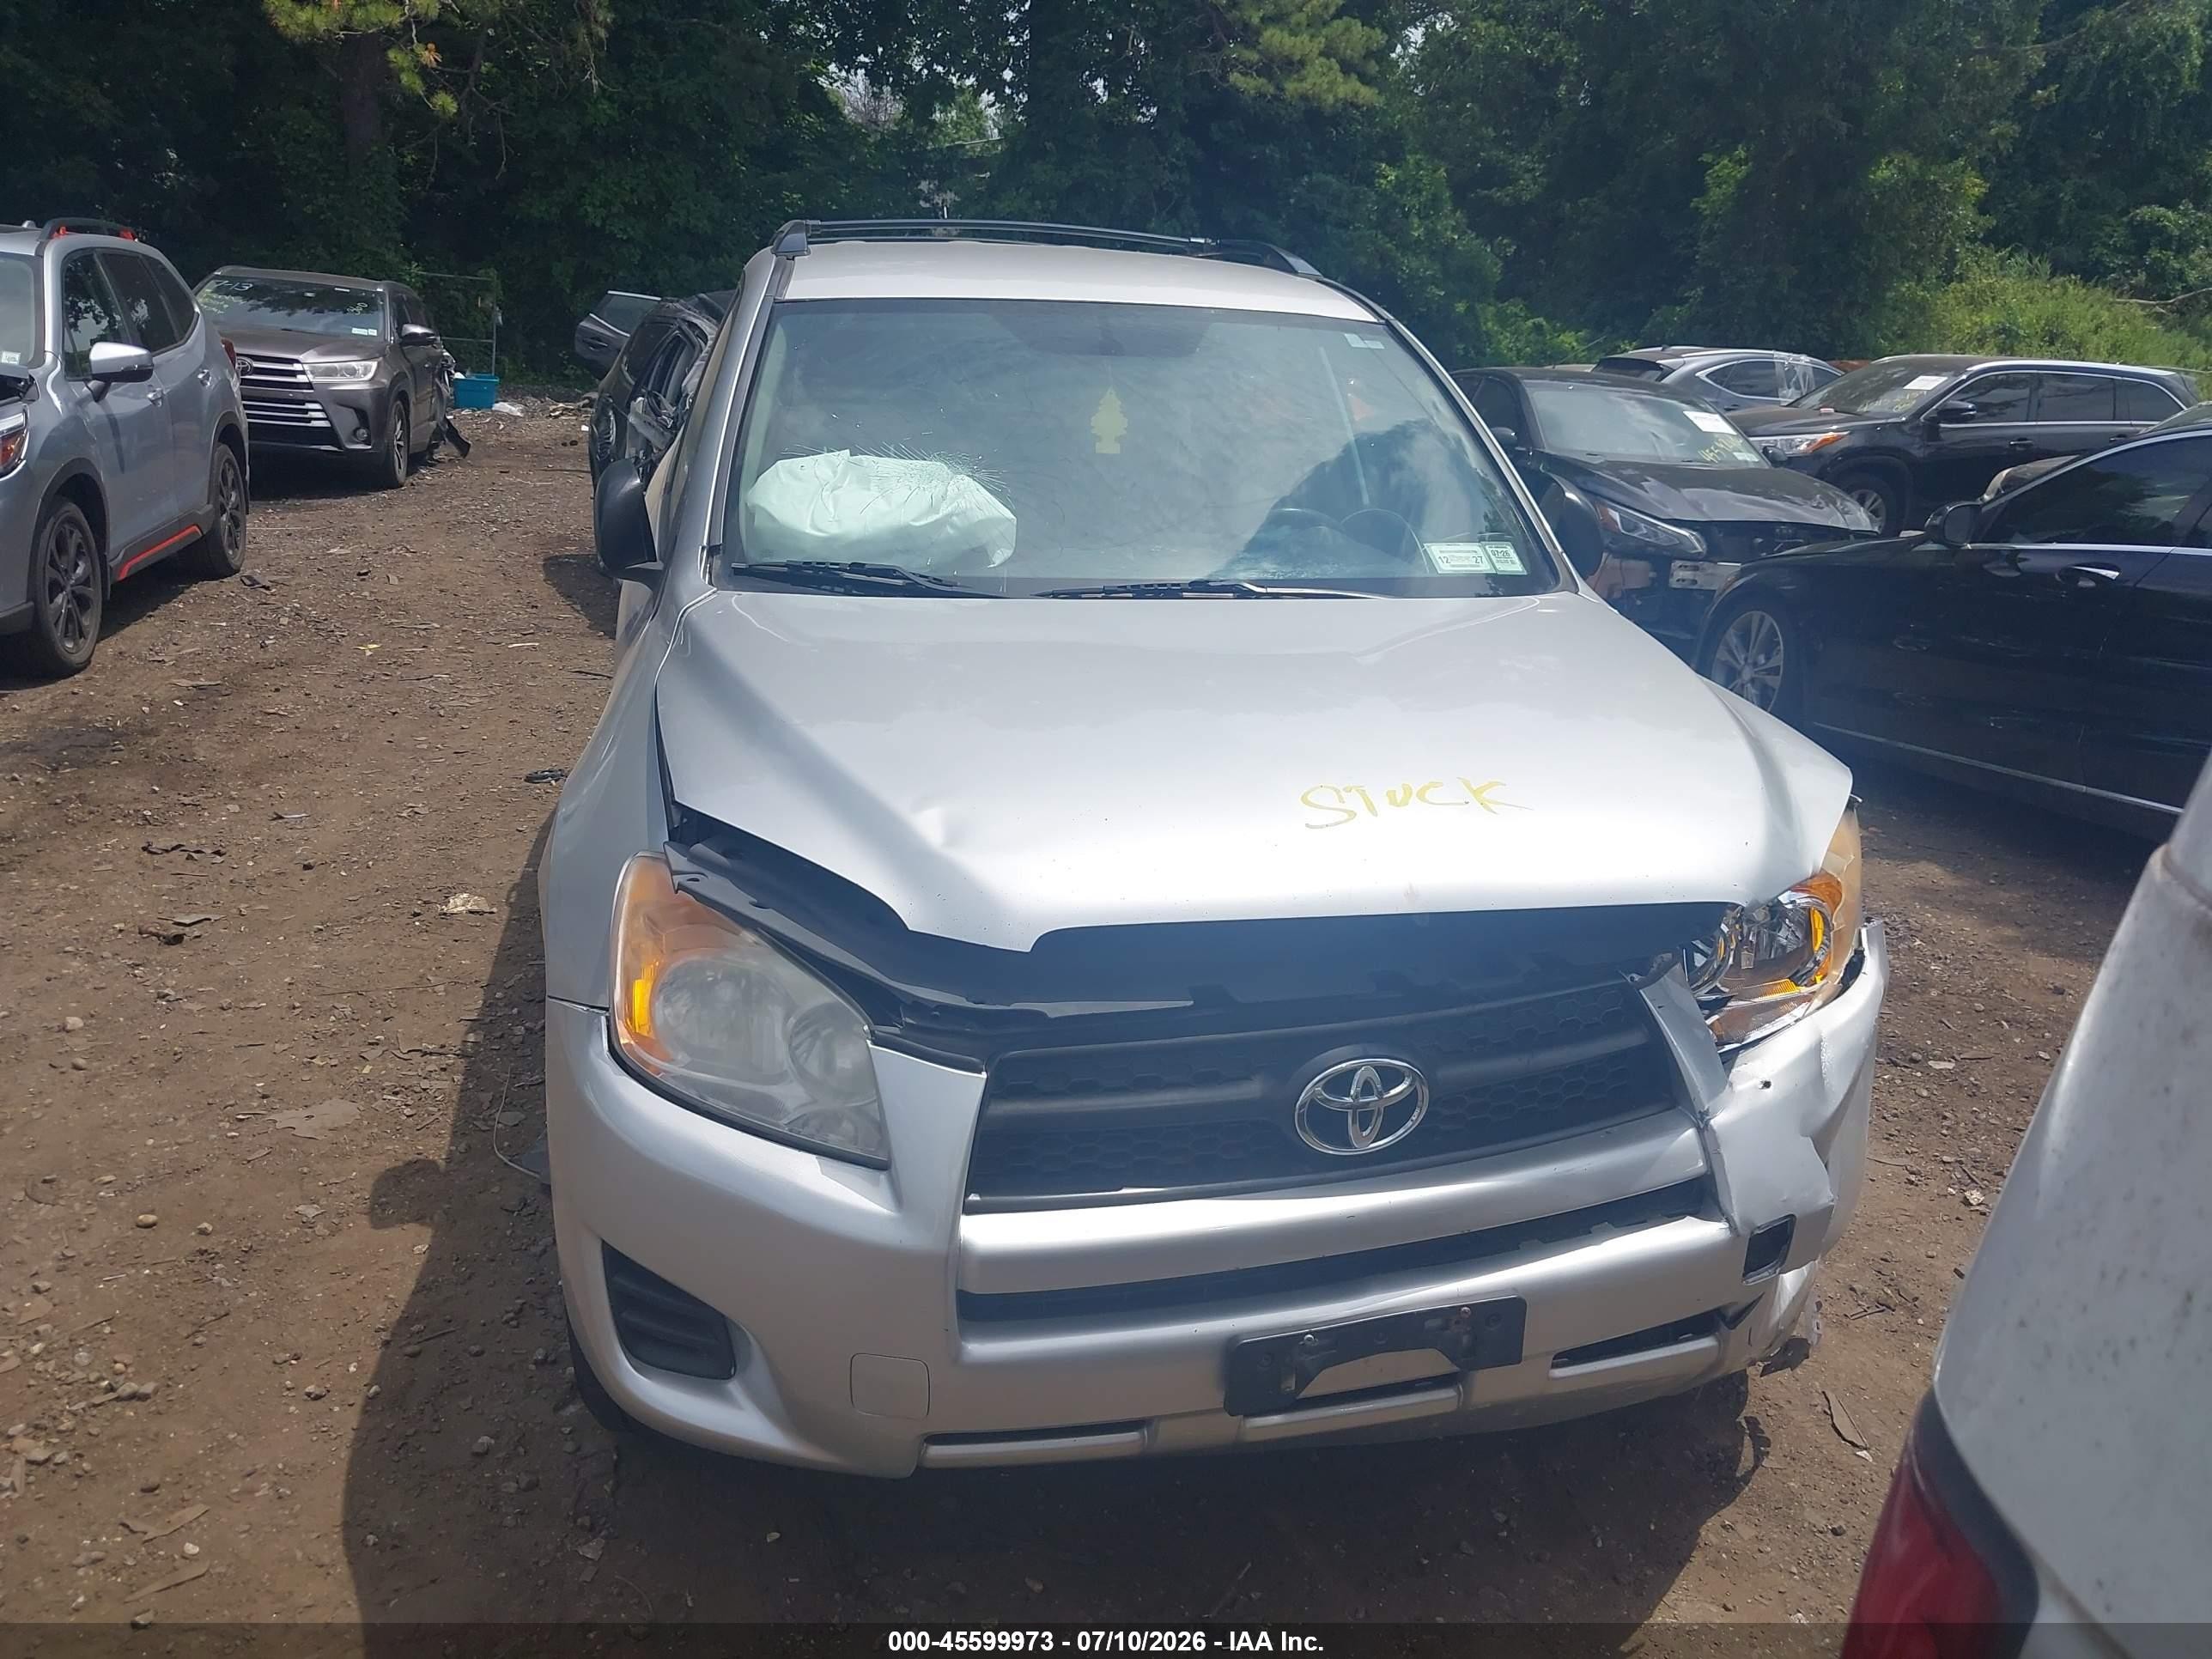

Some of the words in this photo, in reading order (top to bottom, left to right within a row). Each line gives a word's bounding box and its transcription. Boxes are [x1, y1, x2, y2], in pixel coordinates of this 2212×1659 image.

[1437, 556, 1451, 564] 12
[1472, 556, 1484, 564] 27
[1300, 776, 1534, 830] STUCK
